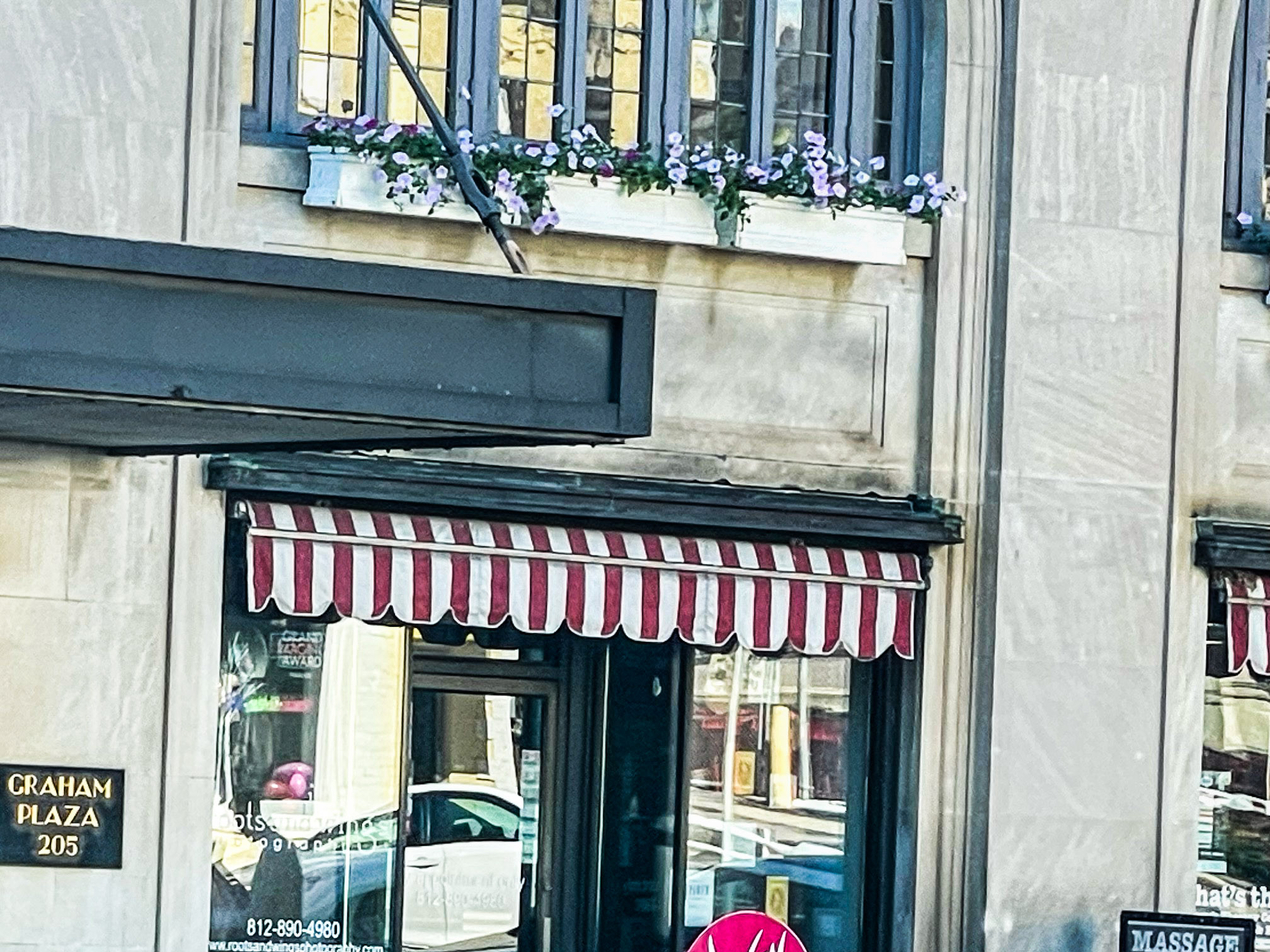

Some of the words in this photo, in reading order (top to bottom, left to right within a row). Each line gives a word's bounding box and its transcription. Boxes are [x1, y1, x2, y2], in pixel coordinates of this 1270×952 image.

[8, 773, 112, 799] GRAHAM
[16, 803, 99, 828] PLAZA
[37, 834, 79, 857] 205
[1195, 883, 1248, 908] hat's
[1251, 886, 1270, 908] th
[246, 917, 341, 939] 812-890-4980
